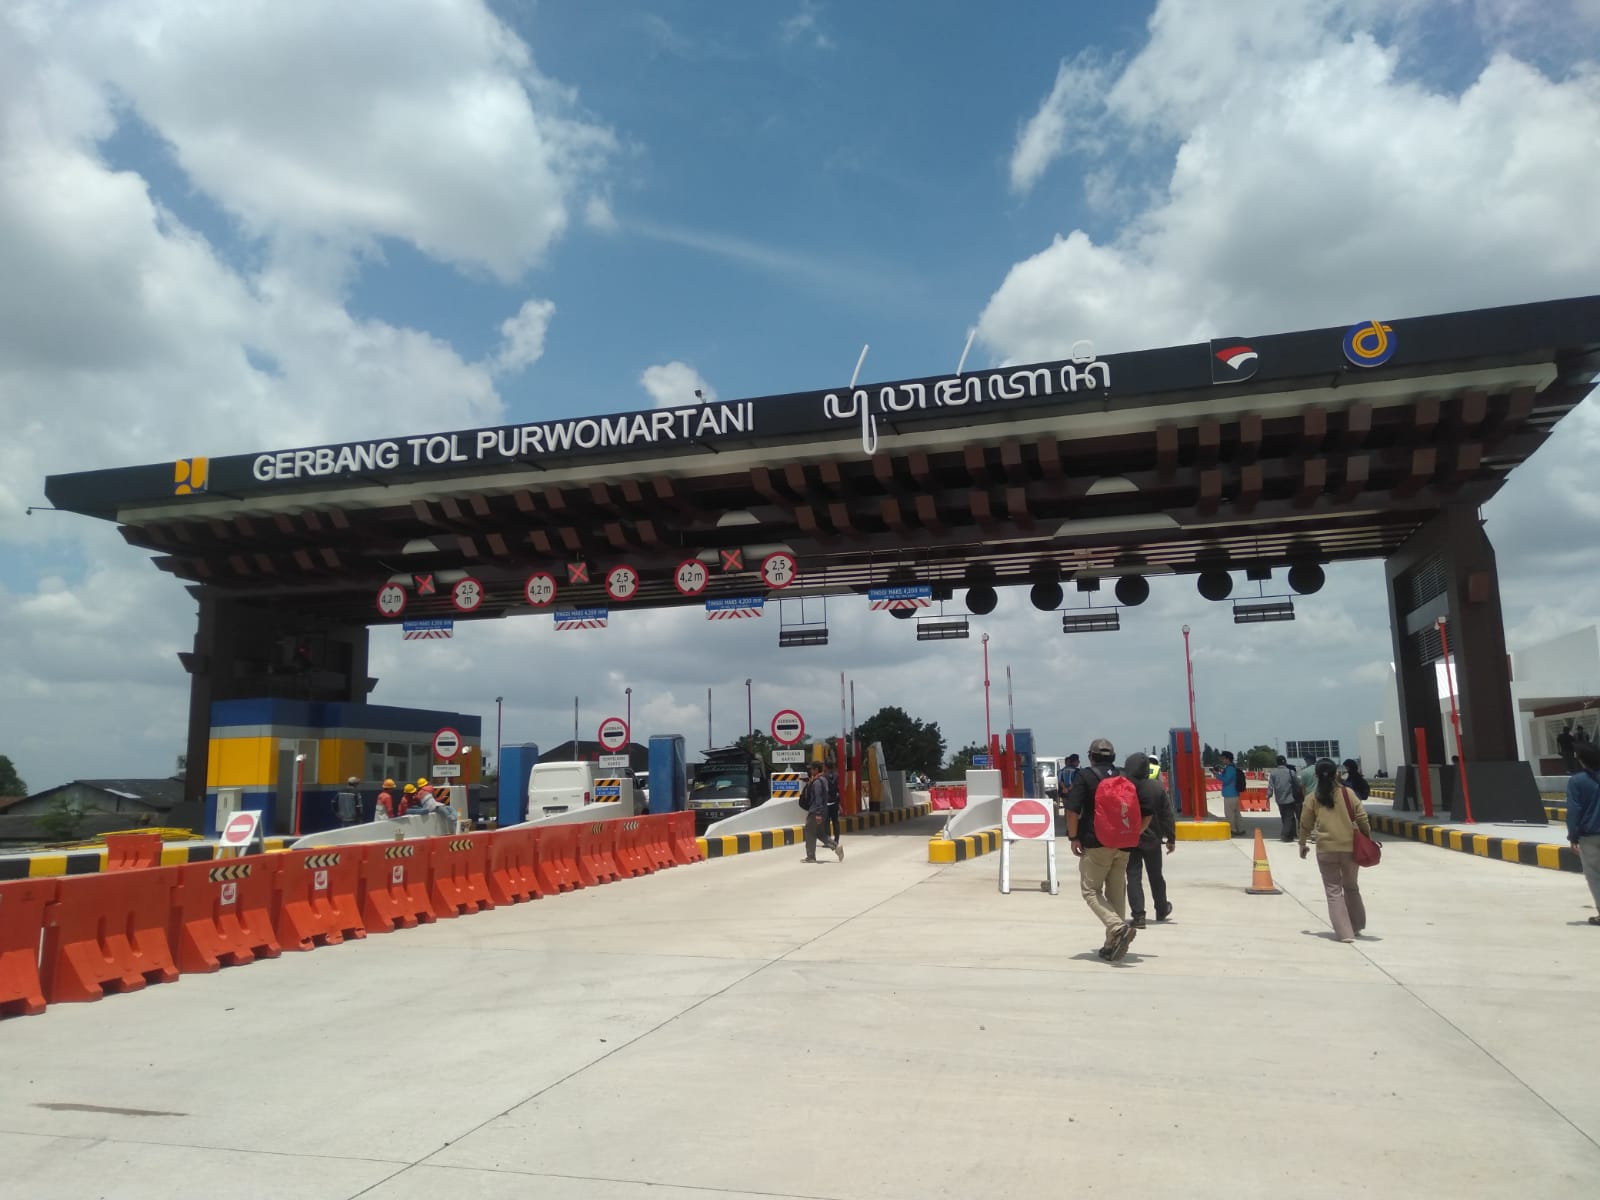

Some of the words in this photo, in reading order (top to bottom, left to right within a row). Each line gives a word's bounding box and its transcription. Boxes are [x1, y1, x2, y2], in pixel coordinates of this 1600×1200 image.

[252, 441, 400, 482] GERBANG
[407, 434, 468, 466] TOL
[476, 401, 754, 459] PURWOMARTANI
[772, 560, 785, 571] 2,5
[616, 573, 629, 583] 2,5
[679, 571, 693, 583] 4,2
[694, 572, 703, 582] m
[775, 572, 784, 581] m
[462, 585, 474, 596] 2,5
[529, 585, 542, 596] 4,2
[543, 585, 551, 594] m
[618, 585, 627, 593] m
[381, 594, 393, 605] 4,2
[464, 596, 472, 605] m
